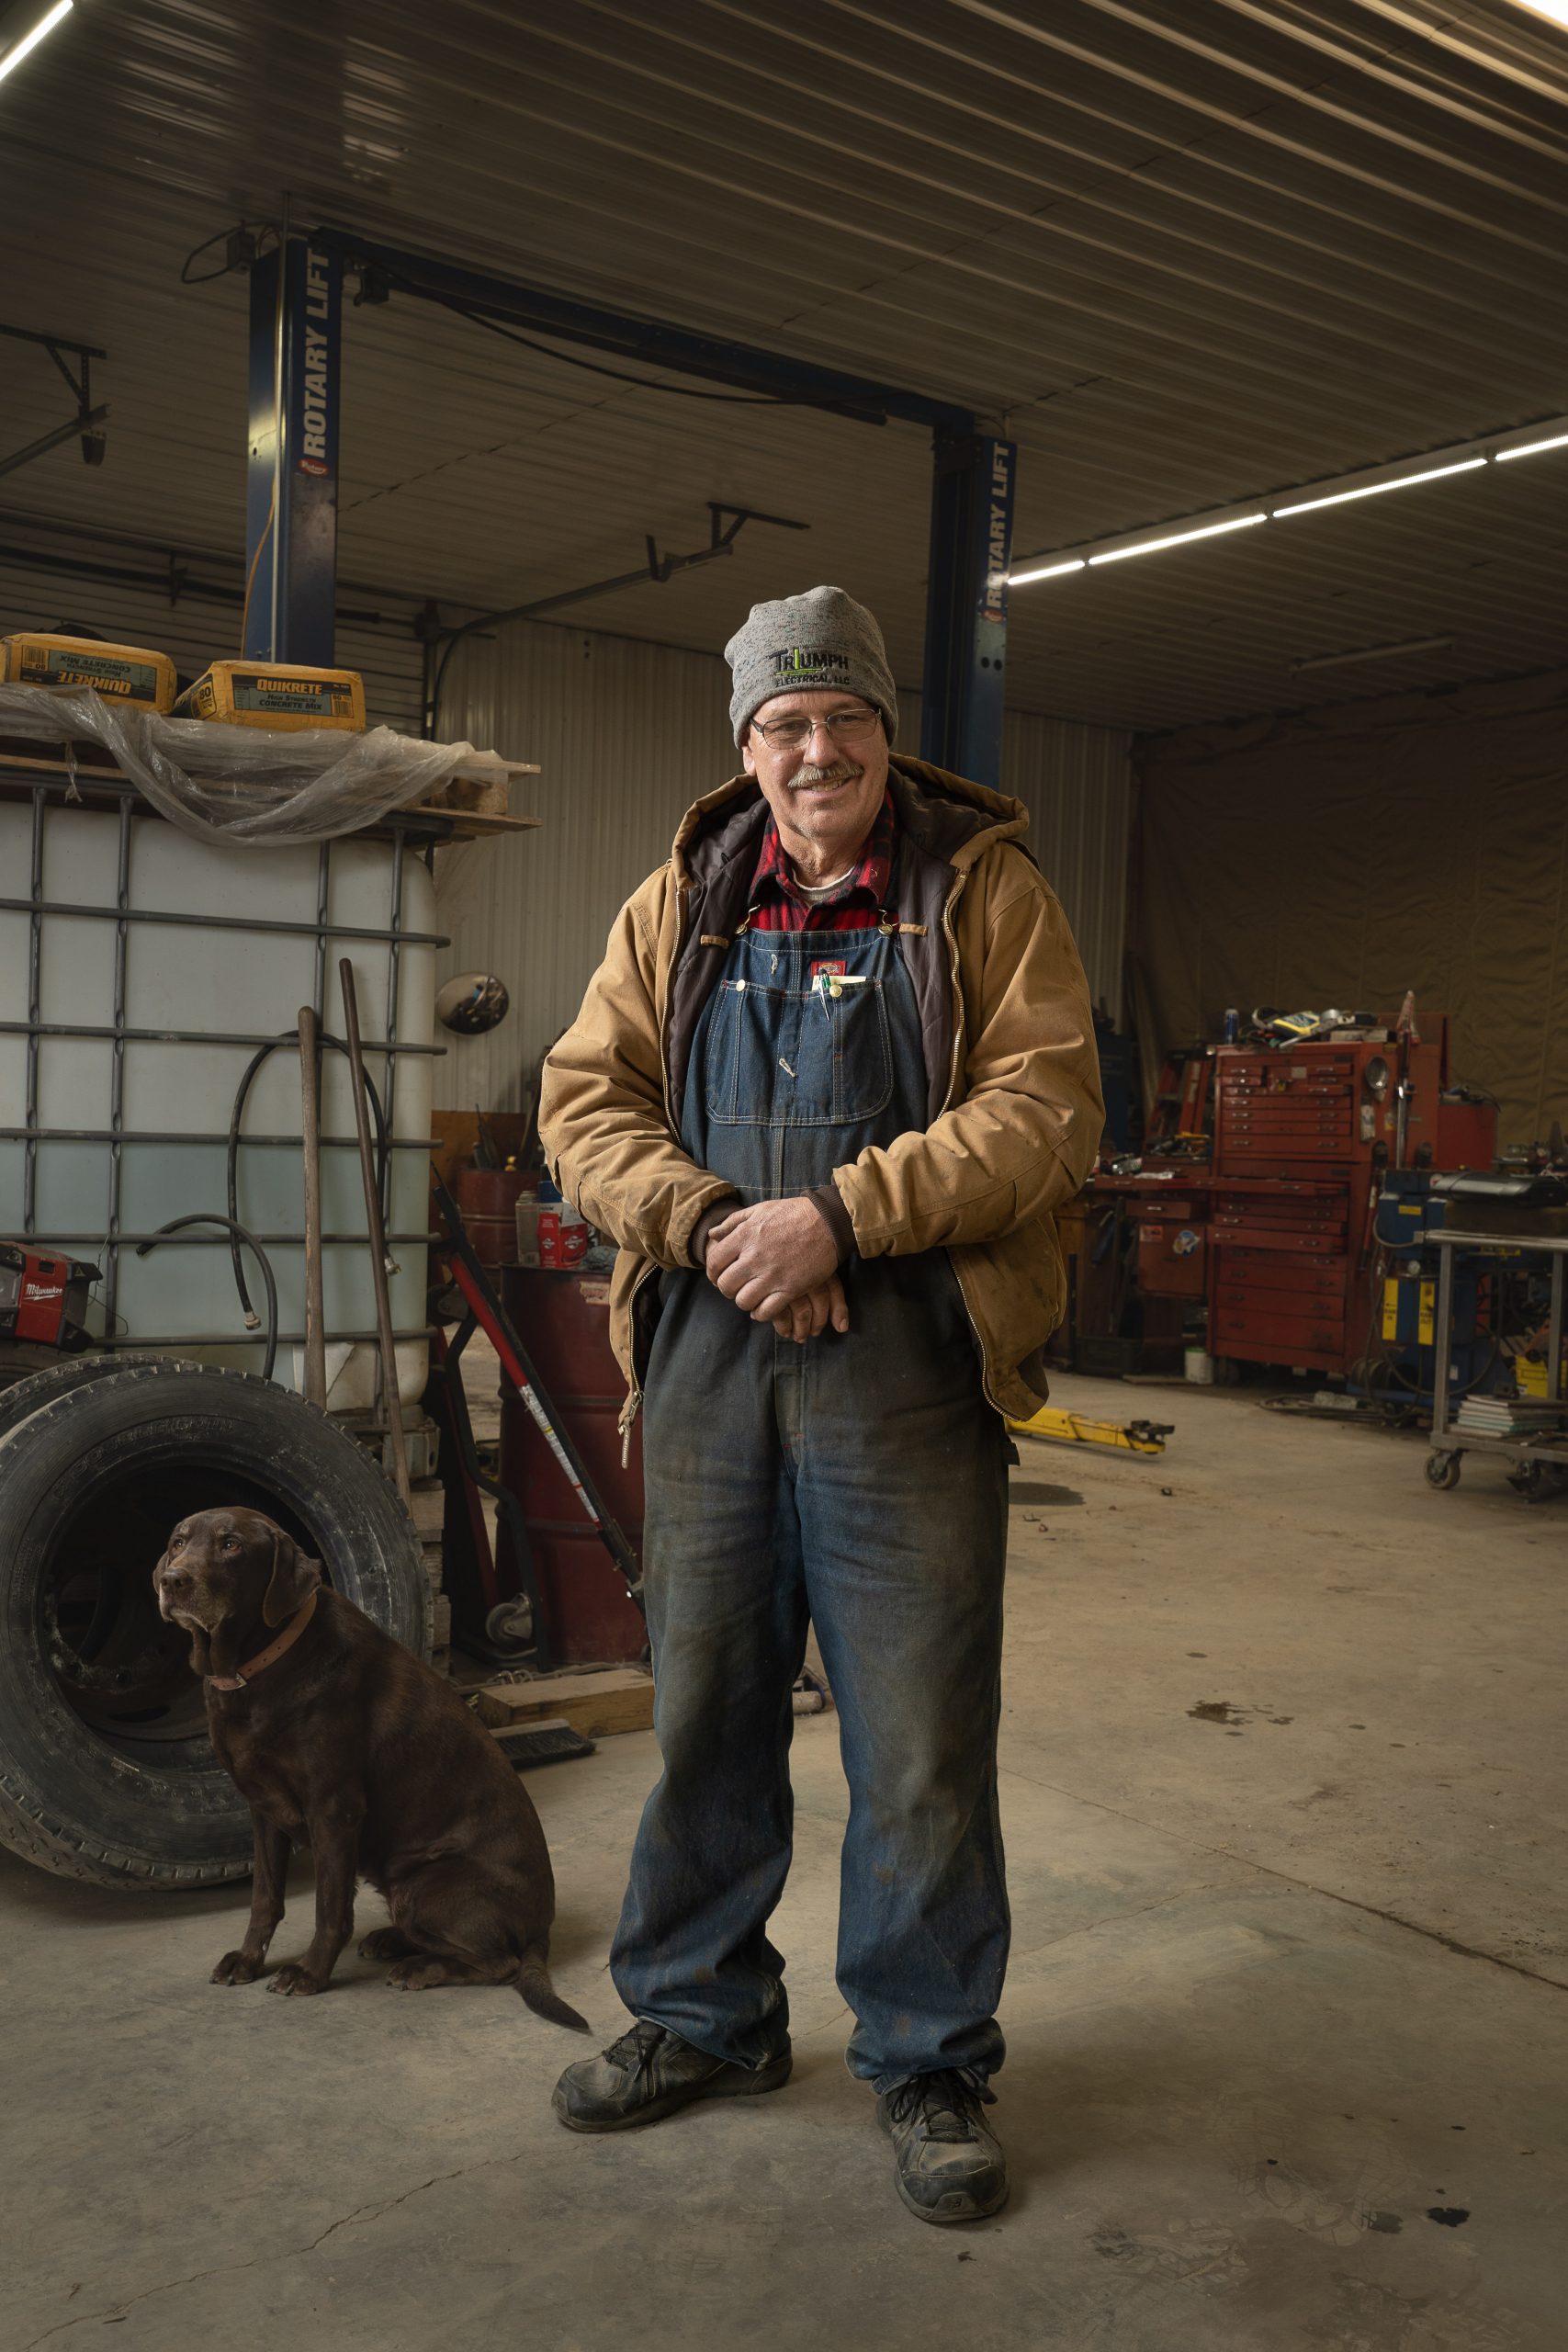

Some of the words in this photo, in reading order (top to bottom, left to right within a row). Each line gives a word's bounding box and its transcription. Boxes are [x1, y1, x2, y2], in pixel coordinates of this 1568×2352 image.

[306, 248, 331, 319] LIFT
[304, 323, 329, 458] ROTARY
[991, 442, 1010, 497] LIFT
[60, 655, 80, 665] MIX
[82, 659, 130, 673] CONCRETE
[769, 647, 849, 670] TRIUMPH
[57, 670, 131, 694] QUIKRETE
[256, 678, 323, 695] QUIKRETE
[834, 675, 850, 685] LLC
[198, 686, 211, 700] 80
[259, 699, 303, 708] CONCRETE
[305, 703, 323, 711] MIX
[26, 1283, 62, 1296] Milwaukee
